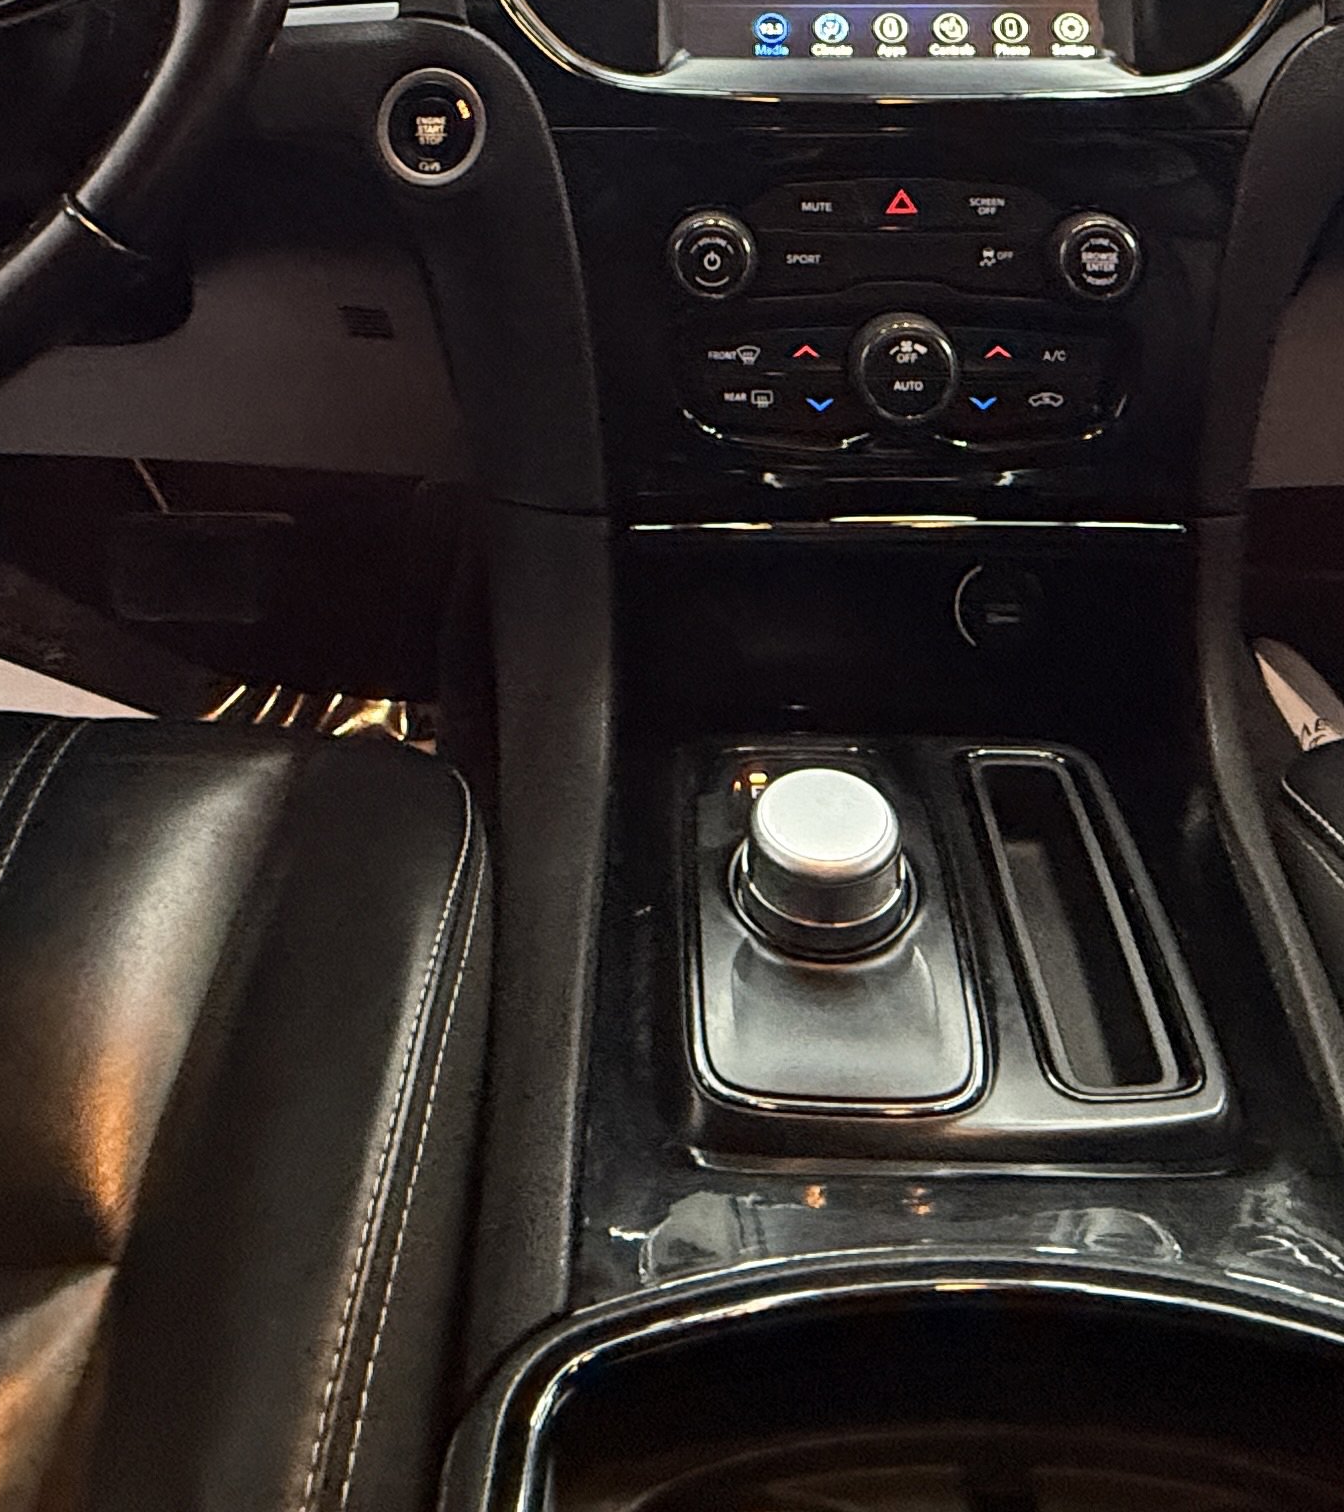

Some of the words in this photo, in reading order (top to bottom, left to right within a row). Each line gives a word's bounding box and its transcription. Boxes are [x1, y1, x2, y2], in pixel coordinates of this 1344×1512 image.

[801, 202, 833, 213] MUTE
[969, 197, 1006, 207] SCREEN
[977, 206, 998, 216] OFF
[786, 254, 822, 265] SPORT
[996, 250, 1014, 261] OFF
[707, 350, 737, 361] FRONT
[895, 352, 919, 365] OFF
[1042, 349, 1067, 362] A/C
[892, 380, 925, 392] AUTO
[723, 391, 748, 402] REAR
